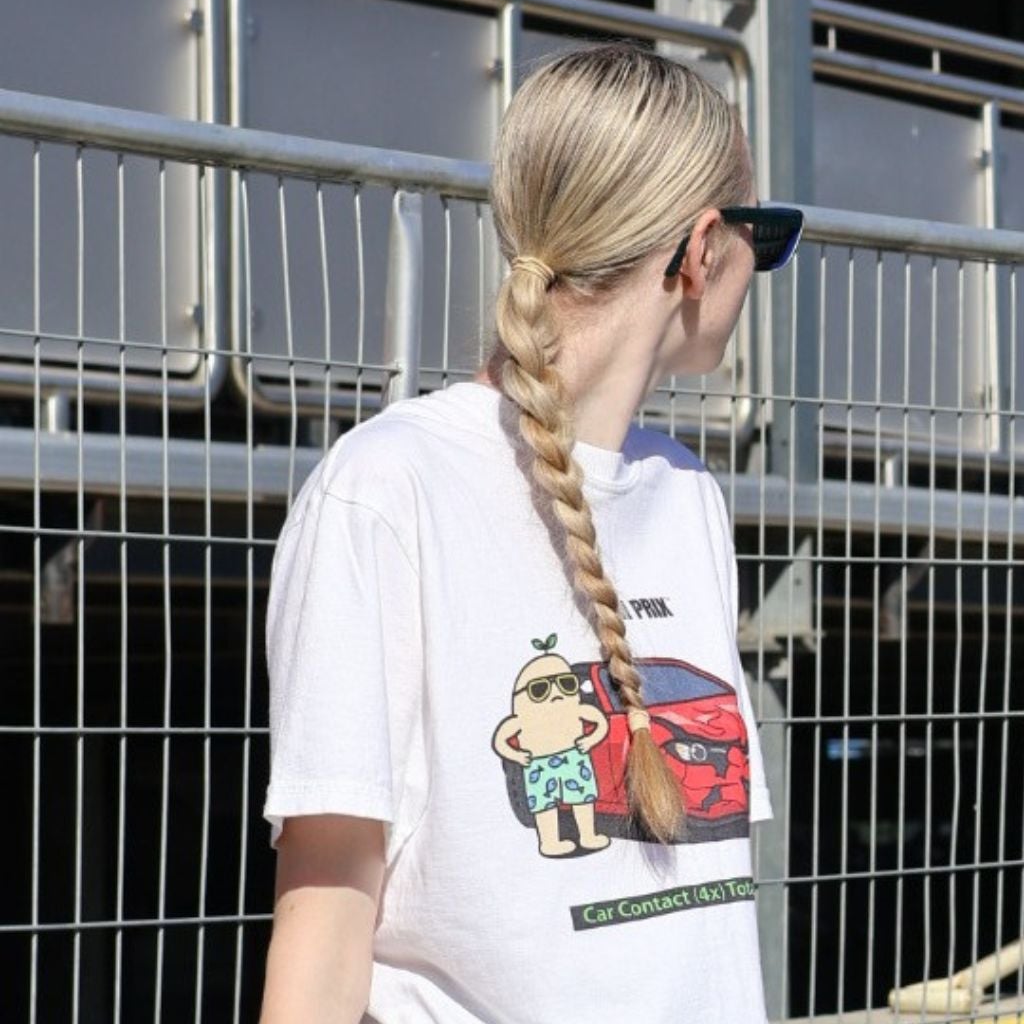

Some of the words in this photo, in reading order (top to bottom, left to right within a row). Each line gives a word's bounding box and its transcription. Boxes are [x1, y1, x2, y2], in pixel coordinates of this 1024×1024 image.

[628, 596, 674, 619] PRIX
[582, 905, 614, 924] Car
[617, 889, 690, 917] Contact
[692, 883, 726, 904] (4x)
[725, 880, 755, 897] Tot
